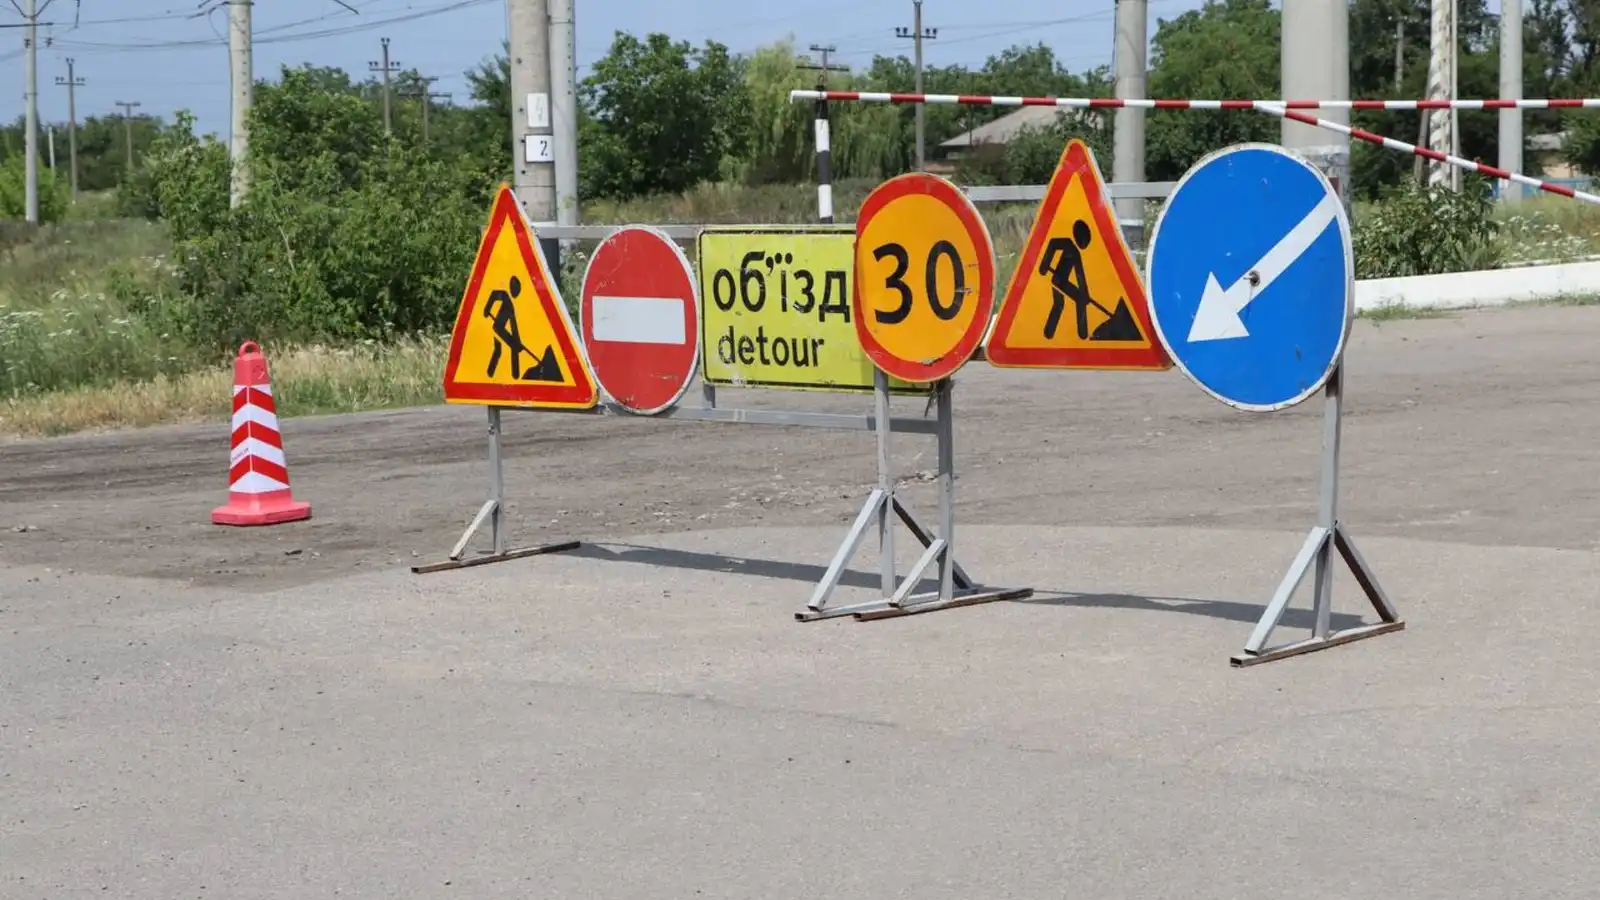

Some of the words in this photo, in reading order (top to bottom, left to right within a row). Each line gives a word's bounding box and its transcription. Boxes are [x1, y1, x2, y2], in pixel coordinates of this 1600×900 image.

[540, 140, 548, 156] 2
[873, 240, 964, 325] 30
[718, 325, 825, 367] detour
